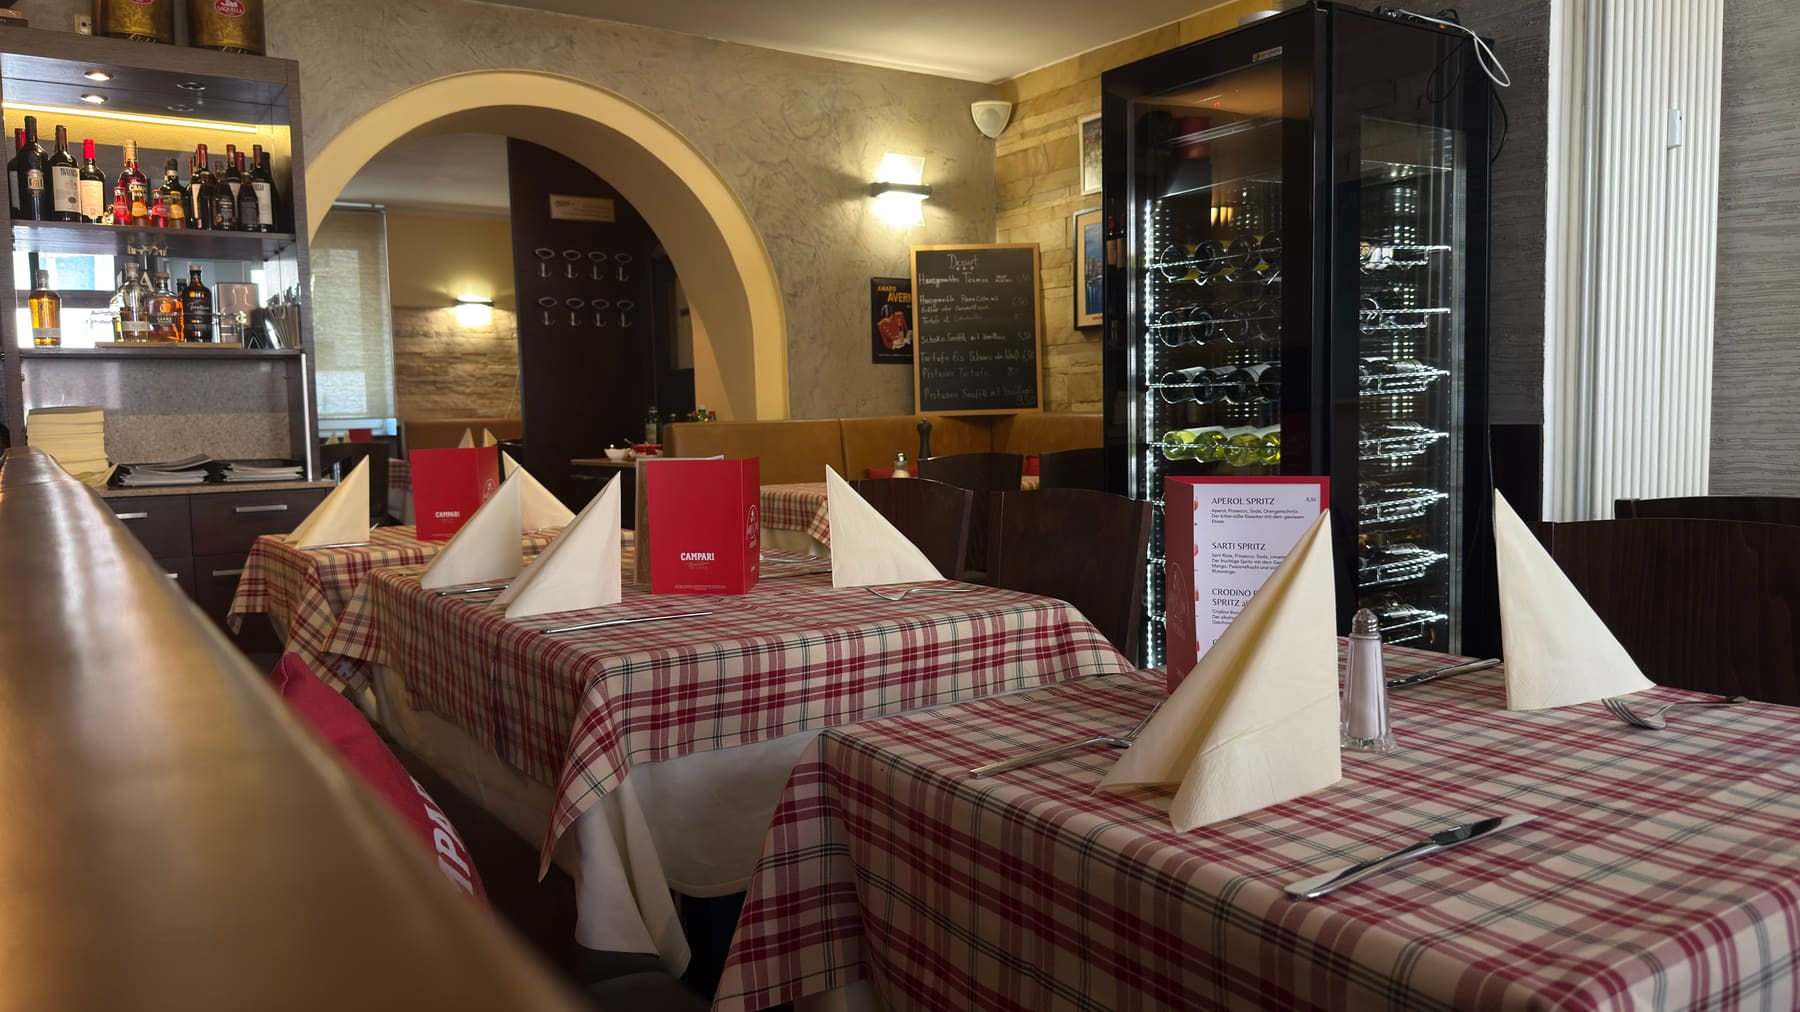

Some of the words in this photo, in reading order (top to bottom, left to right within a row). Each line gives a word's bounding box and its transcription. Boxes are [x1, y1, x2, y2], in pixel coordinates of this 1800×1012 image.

[1237, 542, 1266, 550] SPRITZ
[680, 552, 715, 560] CAMPARI
[1212, 588, 1251, 596] CRODINO
